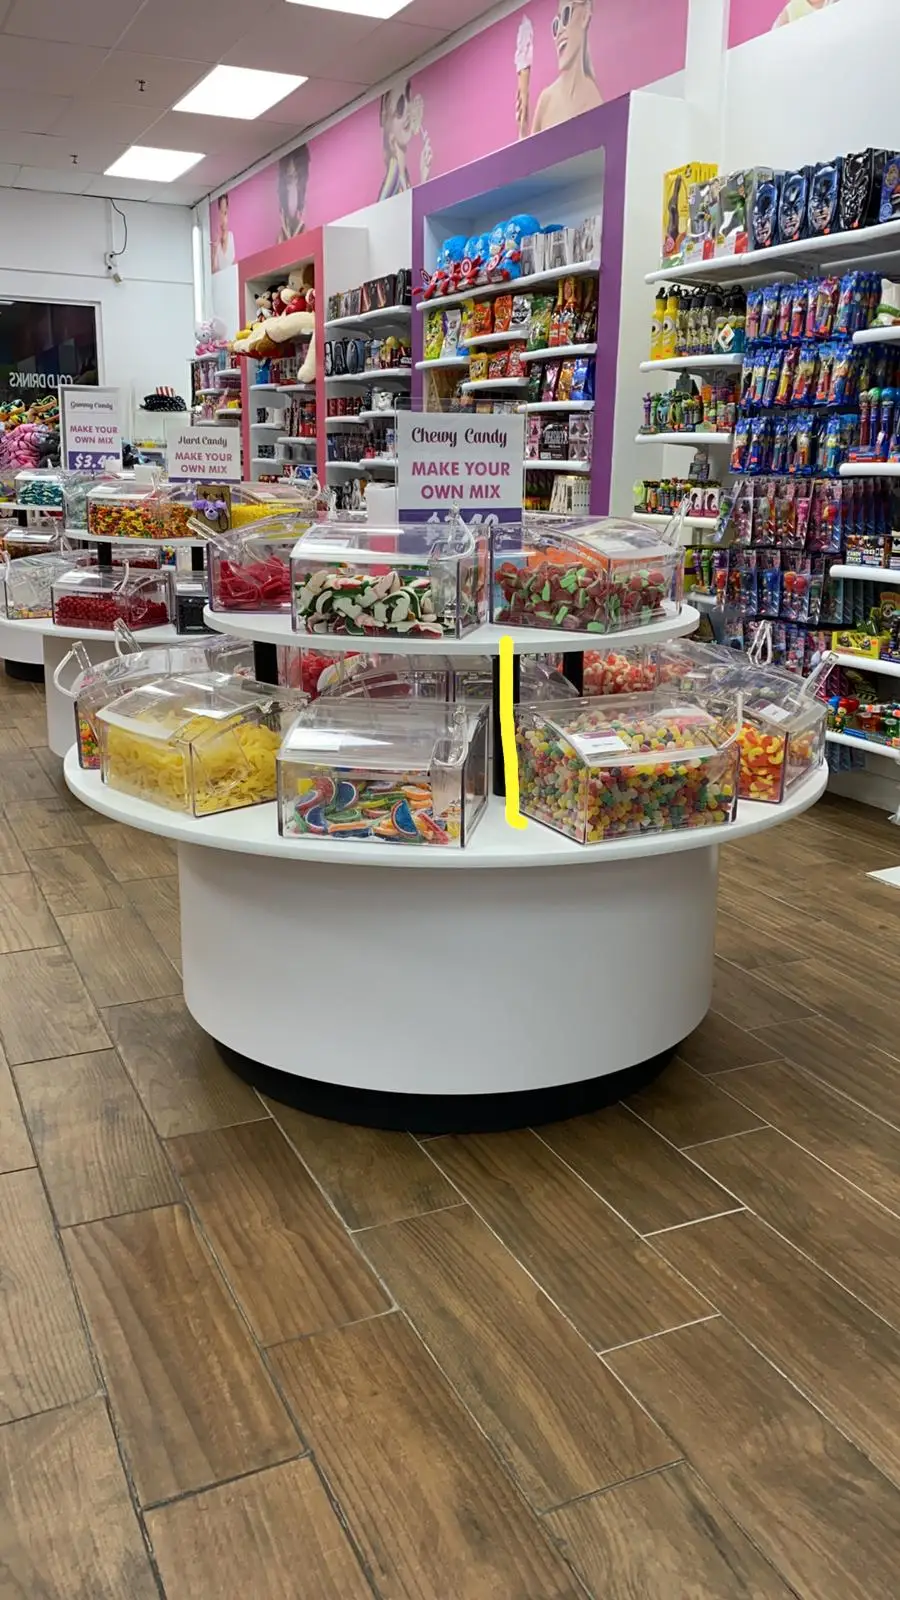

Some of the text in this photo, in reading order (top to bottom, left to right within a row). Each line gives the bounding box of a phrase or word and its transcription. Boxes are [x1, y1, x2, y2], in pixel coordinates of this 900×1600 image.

[70, 401, 113, 411] Gummy Candy
[69, 425, 118, 434] MAKE YOUR
[74, 436, 114, 445] OWN MIX
[178, 435, 227, 447] Hard Candy
[411, 426, 508, 449] Chewy Candy
[174, 452, 233, 462] MAKE YOUR
[180, 464, 228, 474] OWN MIX
[411, 461, 511, 477] MAKE YOUR
[420, 484, 501, 499] OWN MIX
